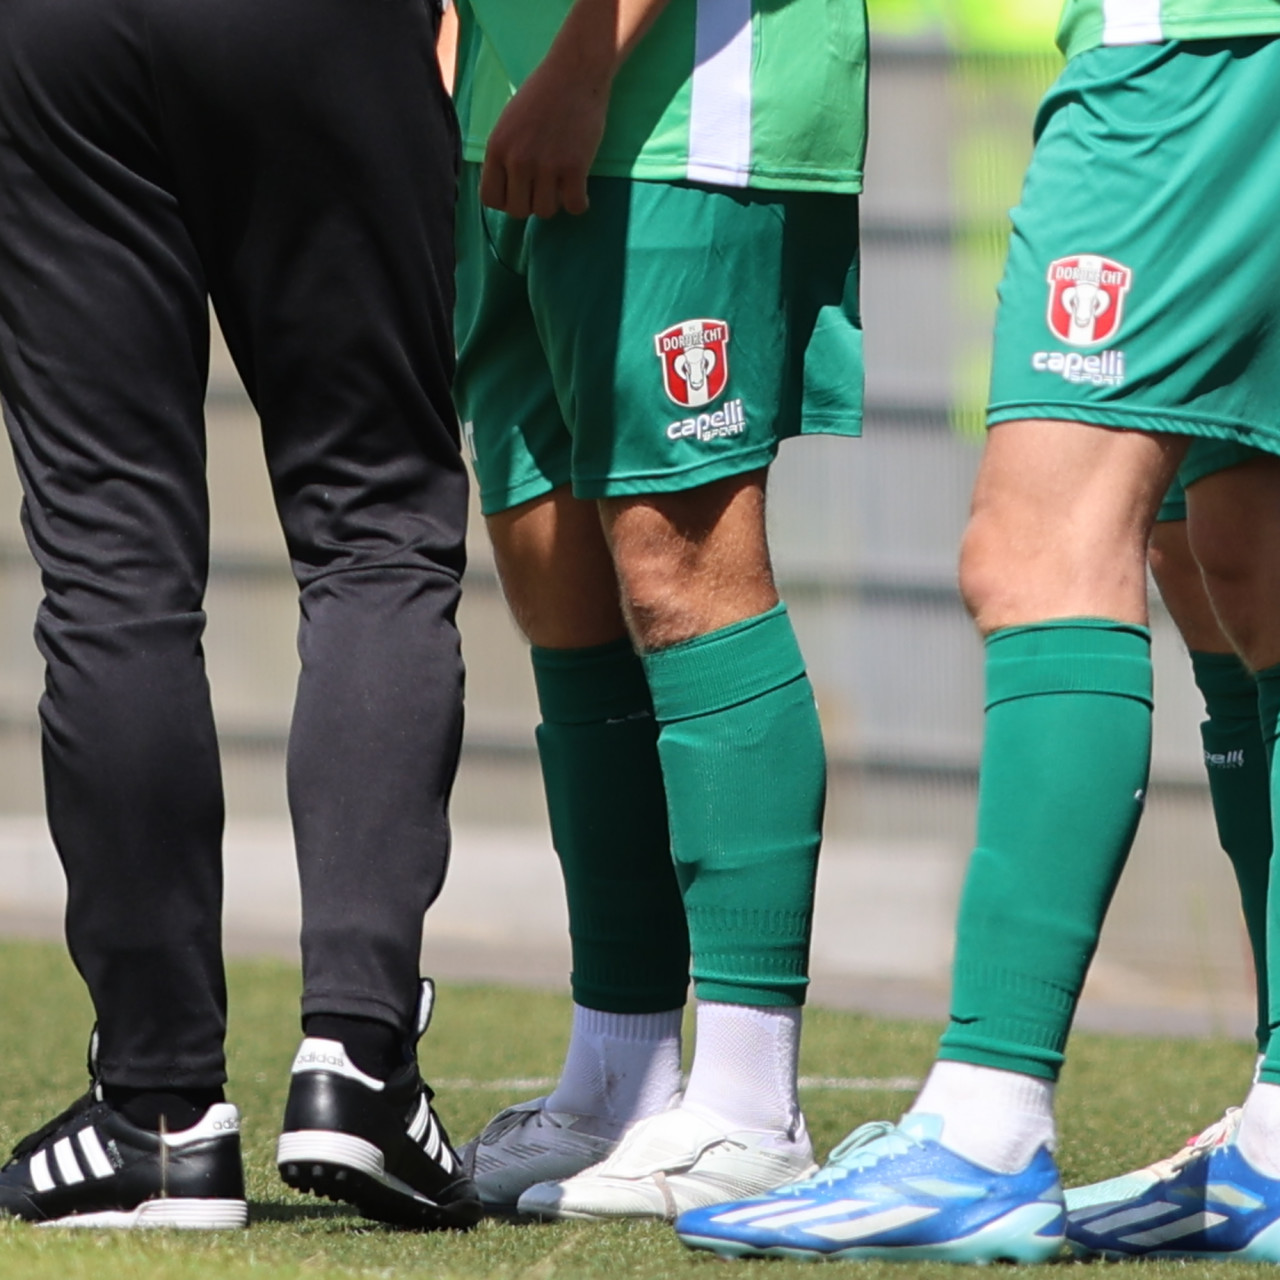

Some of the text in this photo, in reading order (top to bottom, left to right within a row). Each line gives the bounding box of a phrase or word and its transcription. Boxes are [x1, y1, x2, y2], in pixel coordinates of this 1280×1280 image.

[662, 326, 723, 352] DORDRECHT
[1032, 349, 1125, 381] capelli
[666, 398, 744, 440] capelli
[701, 421, 746, 441] SPORT
[297, 1051, 344, 1067] adidas
